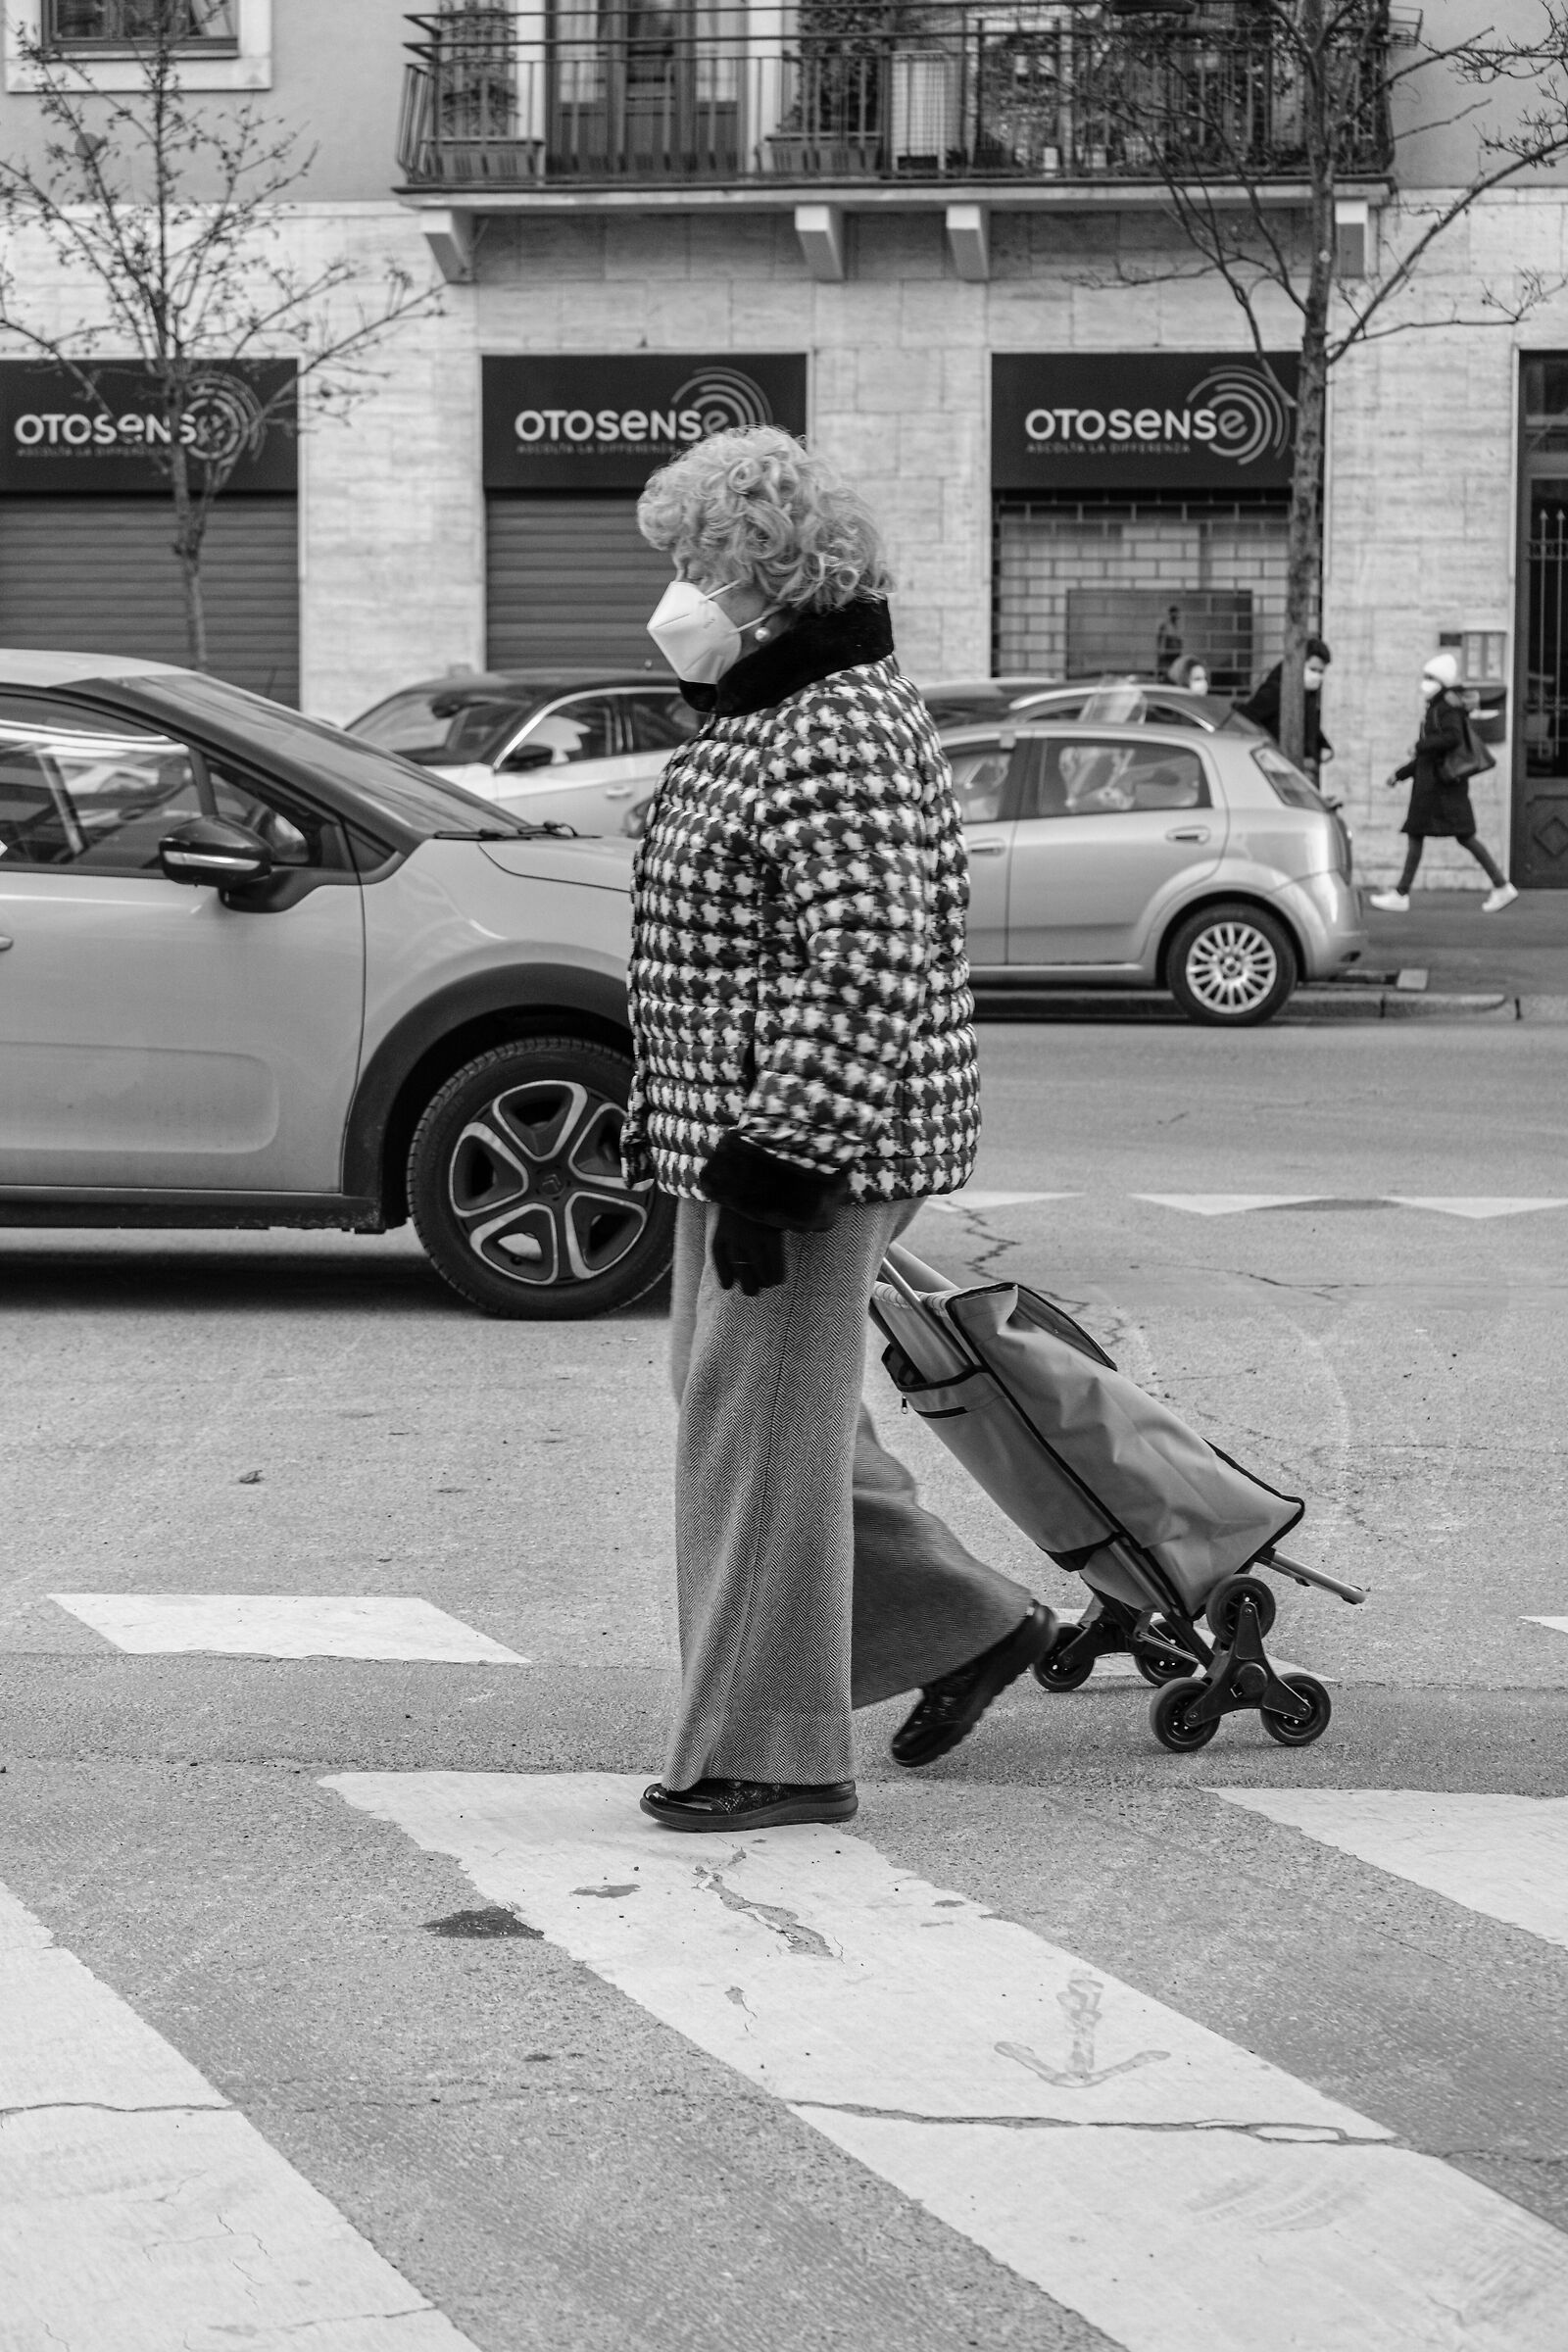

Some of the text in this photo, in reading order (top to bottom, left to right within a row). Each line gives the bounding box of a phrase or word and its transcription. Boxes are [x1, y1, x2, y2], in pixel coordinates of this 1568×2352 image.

[1026, 442, 1191, 454] ASCOLTA LA DIFFERENZA
